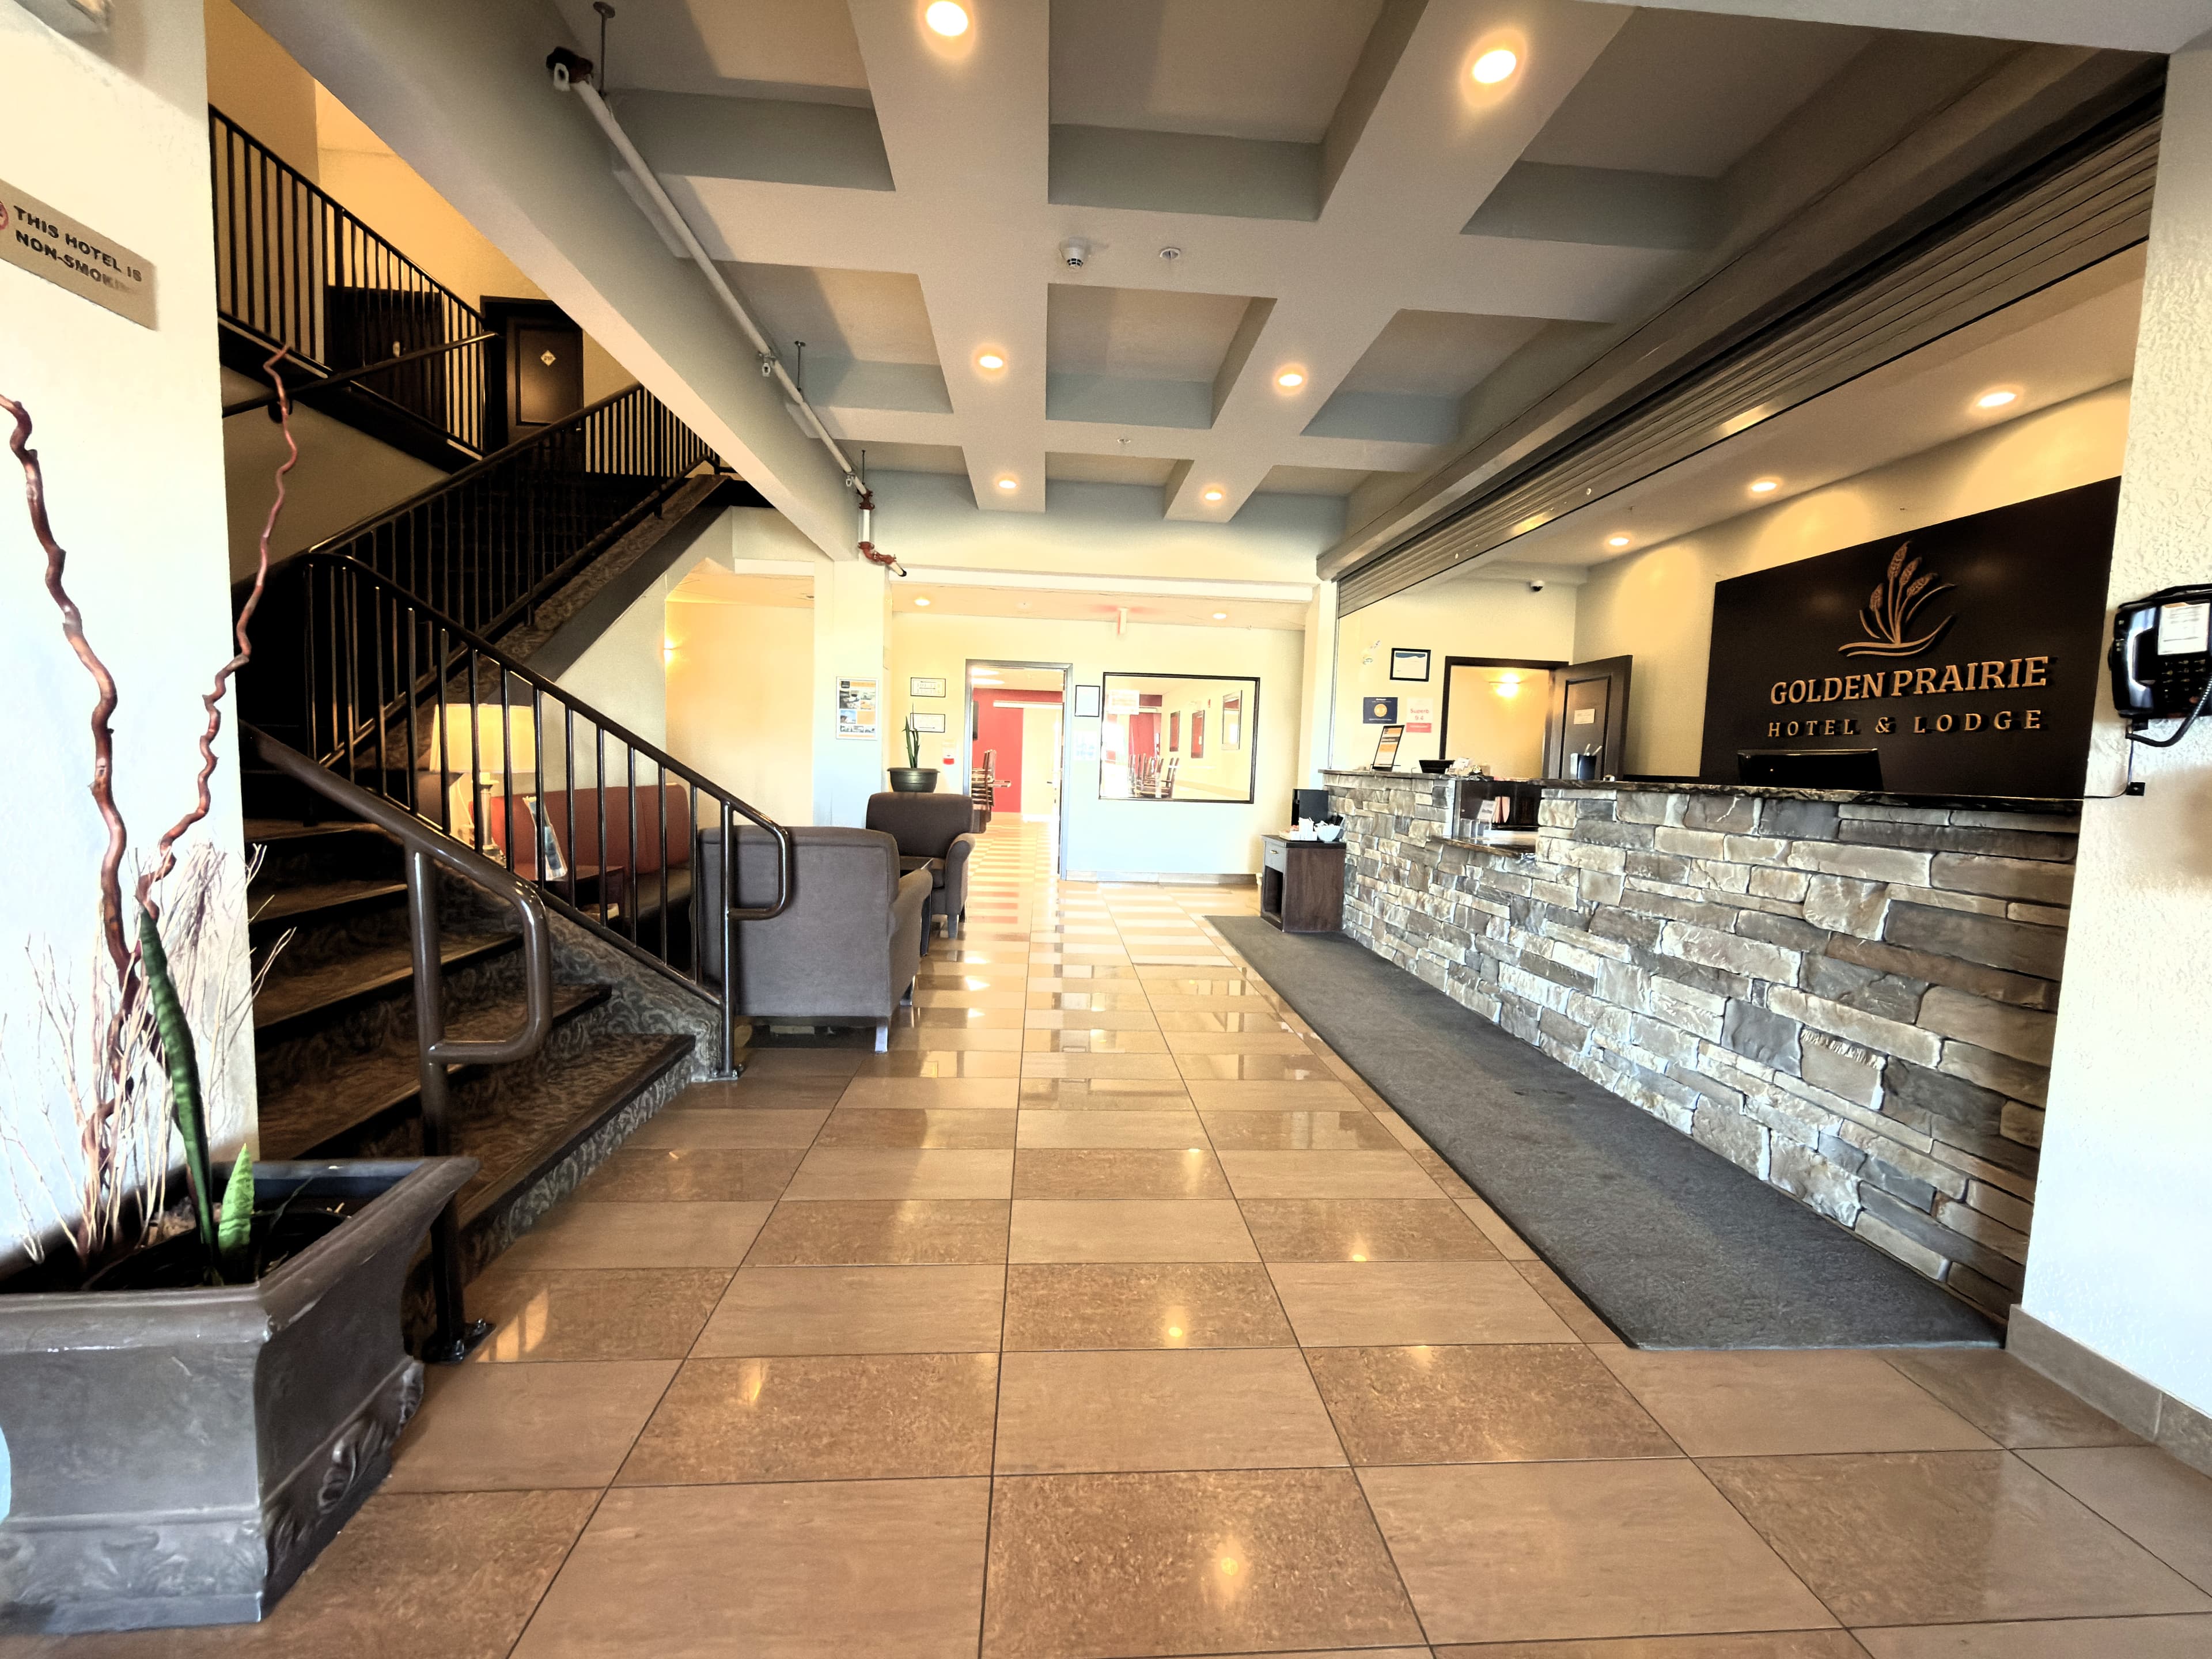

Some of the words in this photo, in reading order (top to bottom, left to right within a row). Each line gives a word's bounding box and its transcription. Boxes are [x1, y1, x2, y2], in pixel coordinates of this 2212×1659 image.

[14, 205, 59, 238] THIS
[65, 233, 122, 272] HOTEL
[127, 266, 142, 282] IS
[16, 229, 134, 293] NON-SMOK
[1770, 672, 1885, 705] GOLDEN
[1891, 656, 2048, 696] PRAIRIE
[1767, 719, 1854, 737] HOTEL
[1875, 717, 1890, 733] &
[1912, 710, 2041, 734] LODGE
